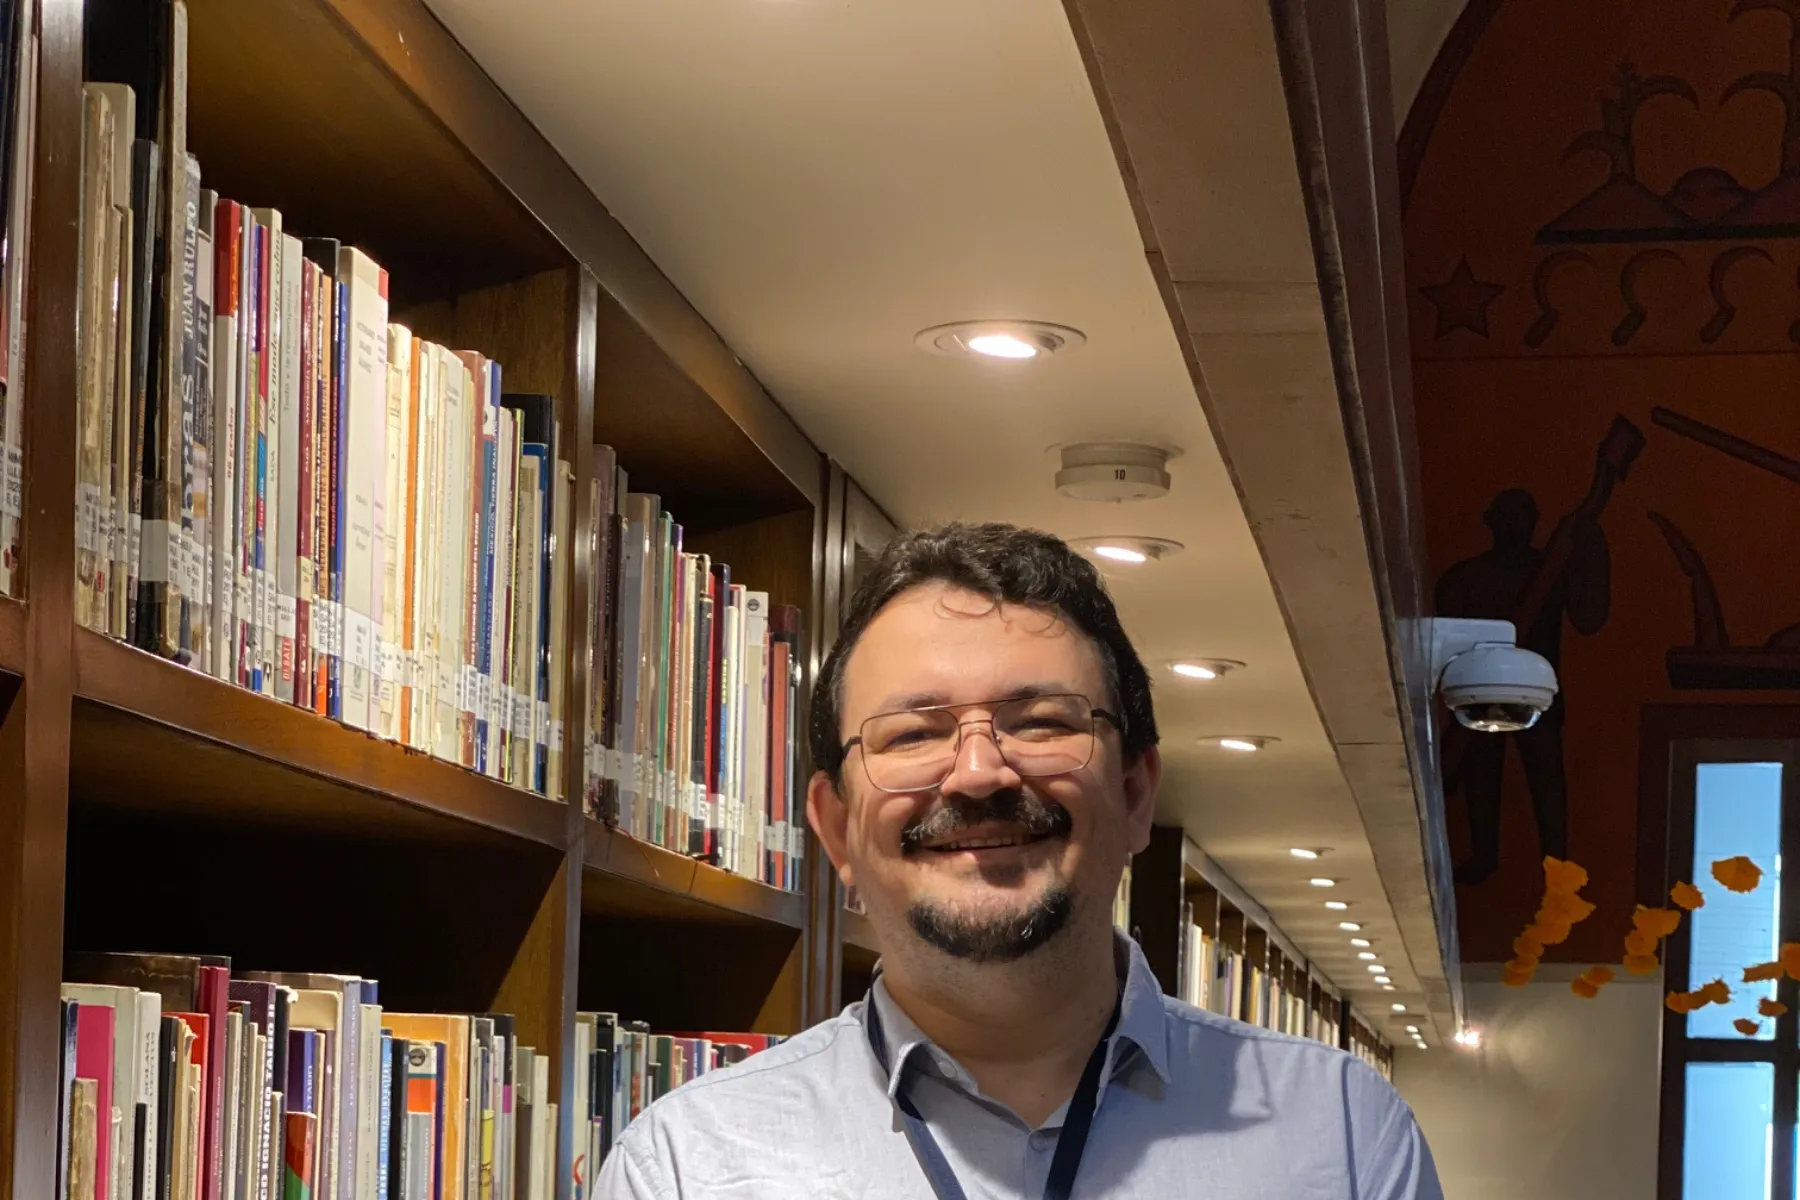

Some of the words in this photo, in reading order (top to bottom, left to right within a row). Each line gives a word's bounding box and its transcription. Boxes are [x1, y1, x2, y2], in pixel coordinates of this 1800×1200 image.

[183, 201, 197, 276] RULFO
[182, 277, 196, 339] JUAN
[181, 374, 194, 532] bras
[1114, 469, 1126, 480] 10
[268, 1004, 275, 1017] II
[264, 1026, 275, 1082] TAIBO
[261, 1087, 272, 1170] IGNACIO
